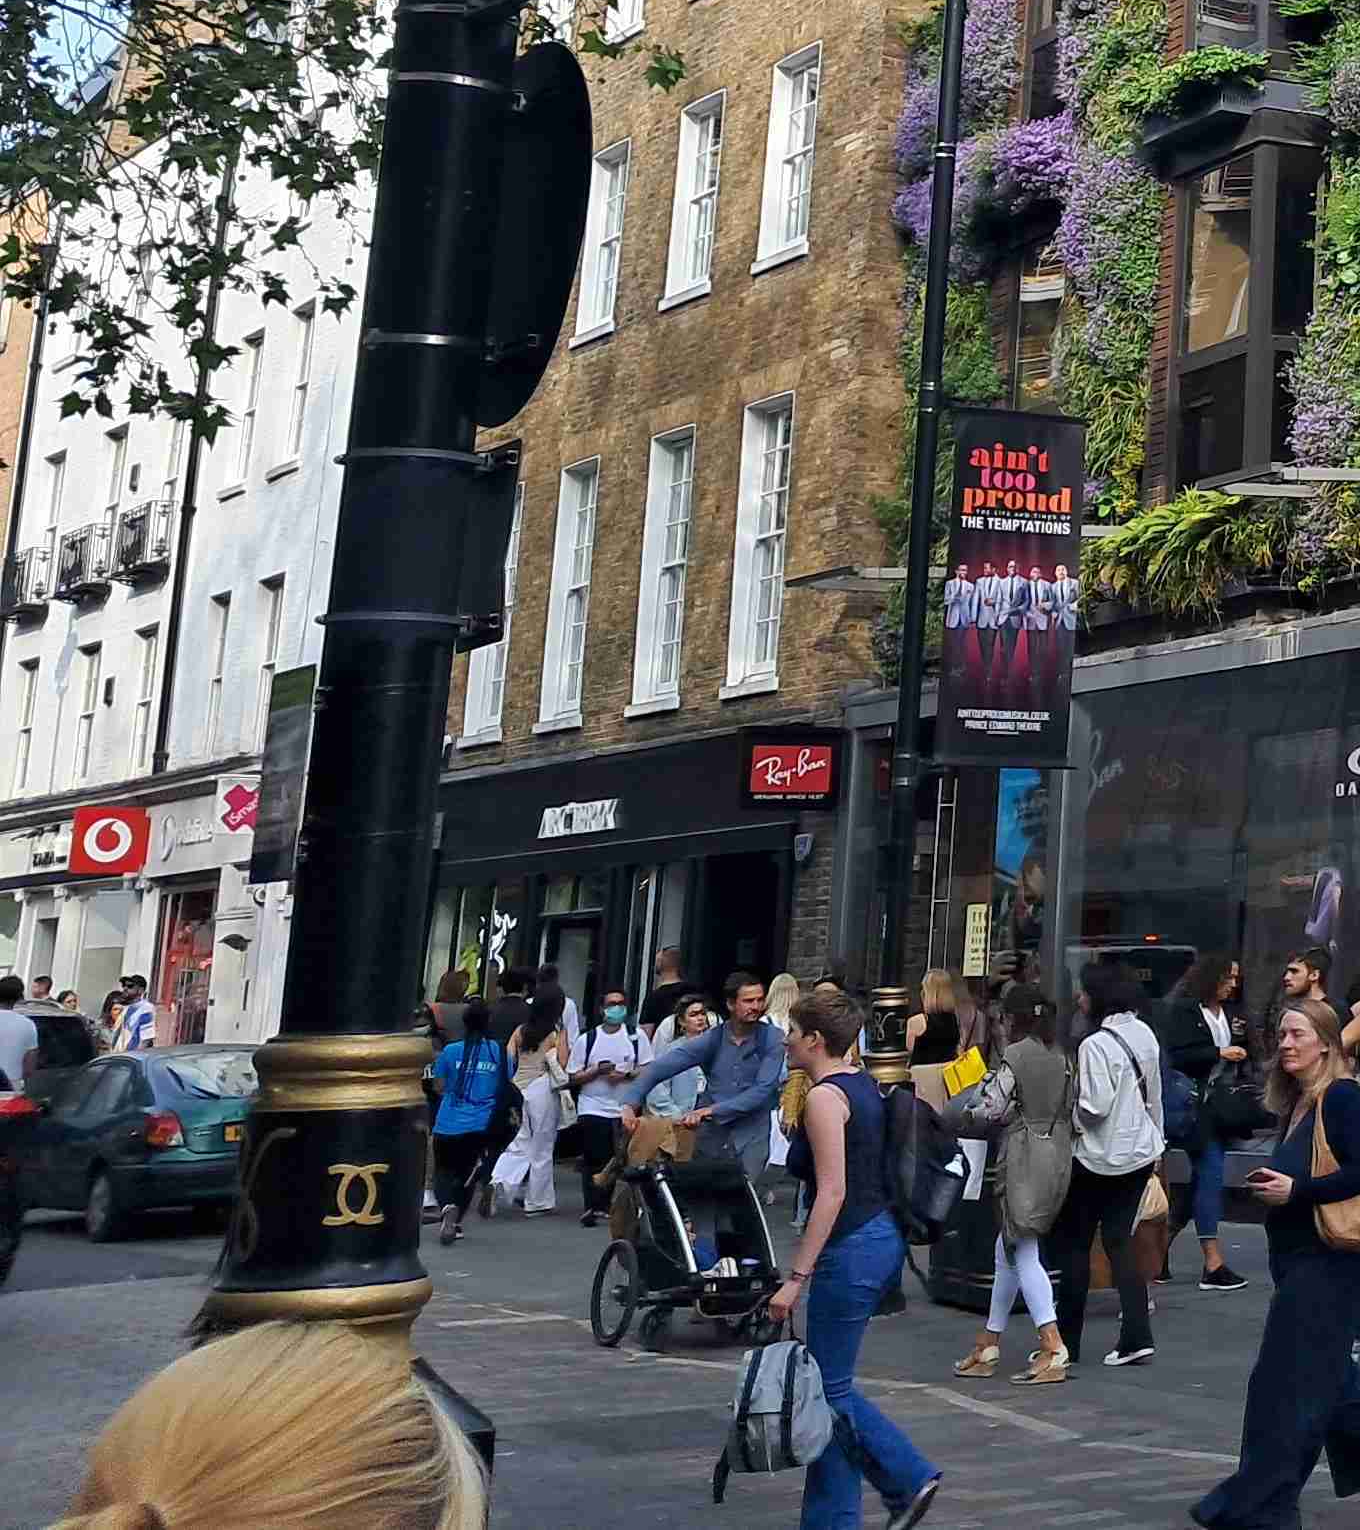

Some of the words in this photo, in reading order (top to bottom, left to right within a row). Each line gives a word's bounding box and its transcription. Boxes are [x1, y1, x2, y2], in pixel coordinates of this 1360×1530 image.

[969, 442, 1048, 472] ain't
[980, 467, 1036, 490] too
[962, 487, 1072, 514] proud
[961, 515, 984, 529] THE
[987, 517, 1072, 535] TEMPTATIONS
[755, 748, 827, 787] Ray-Ban
